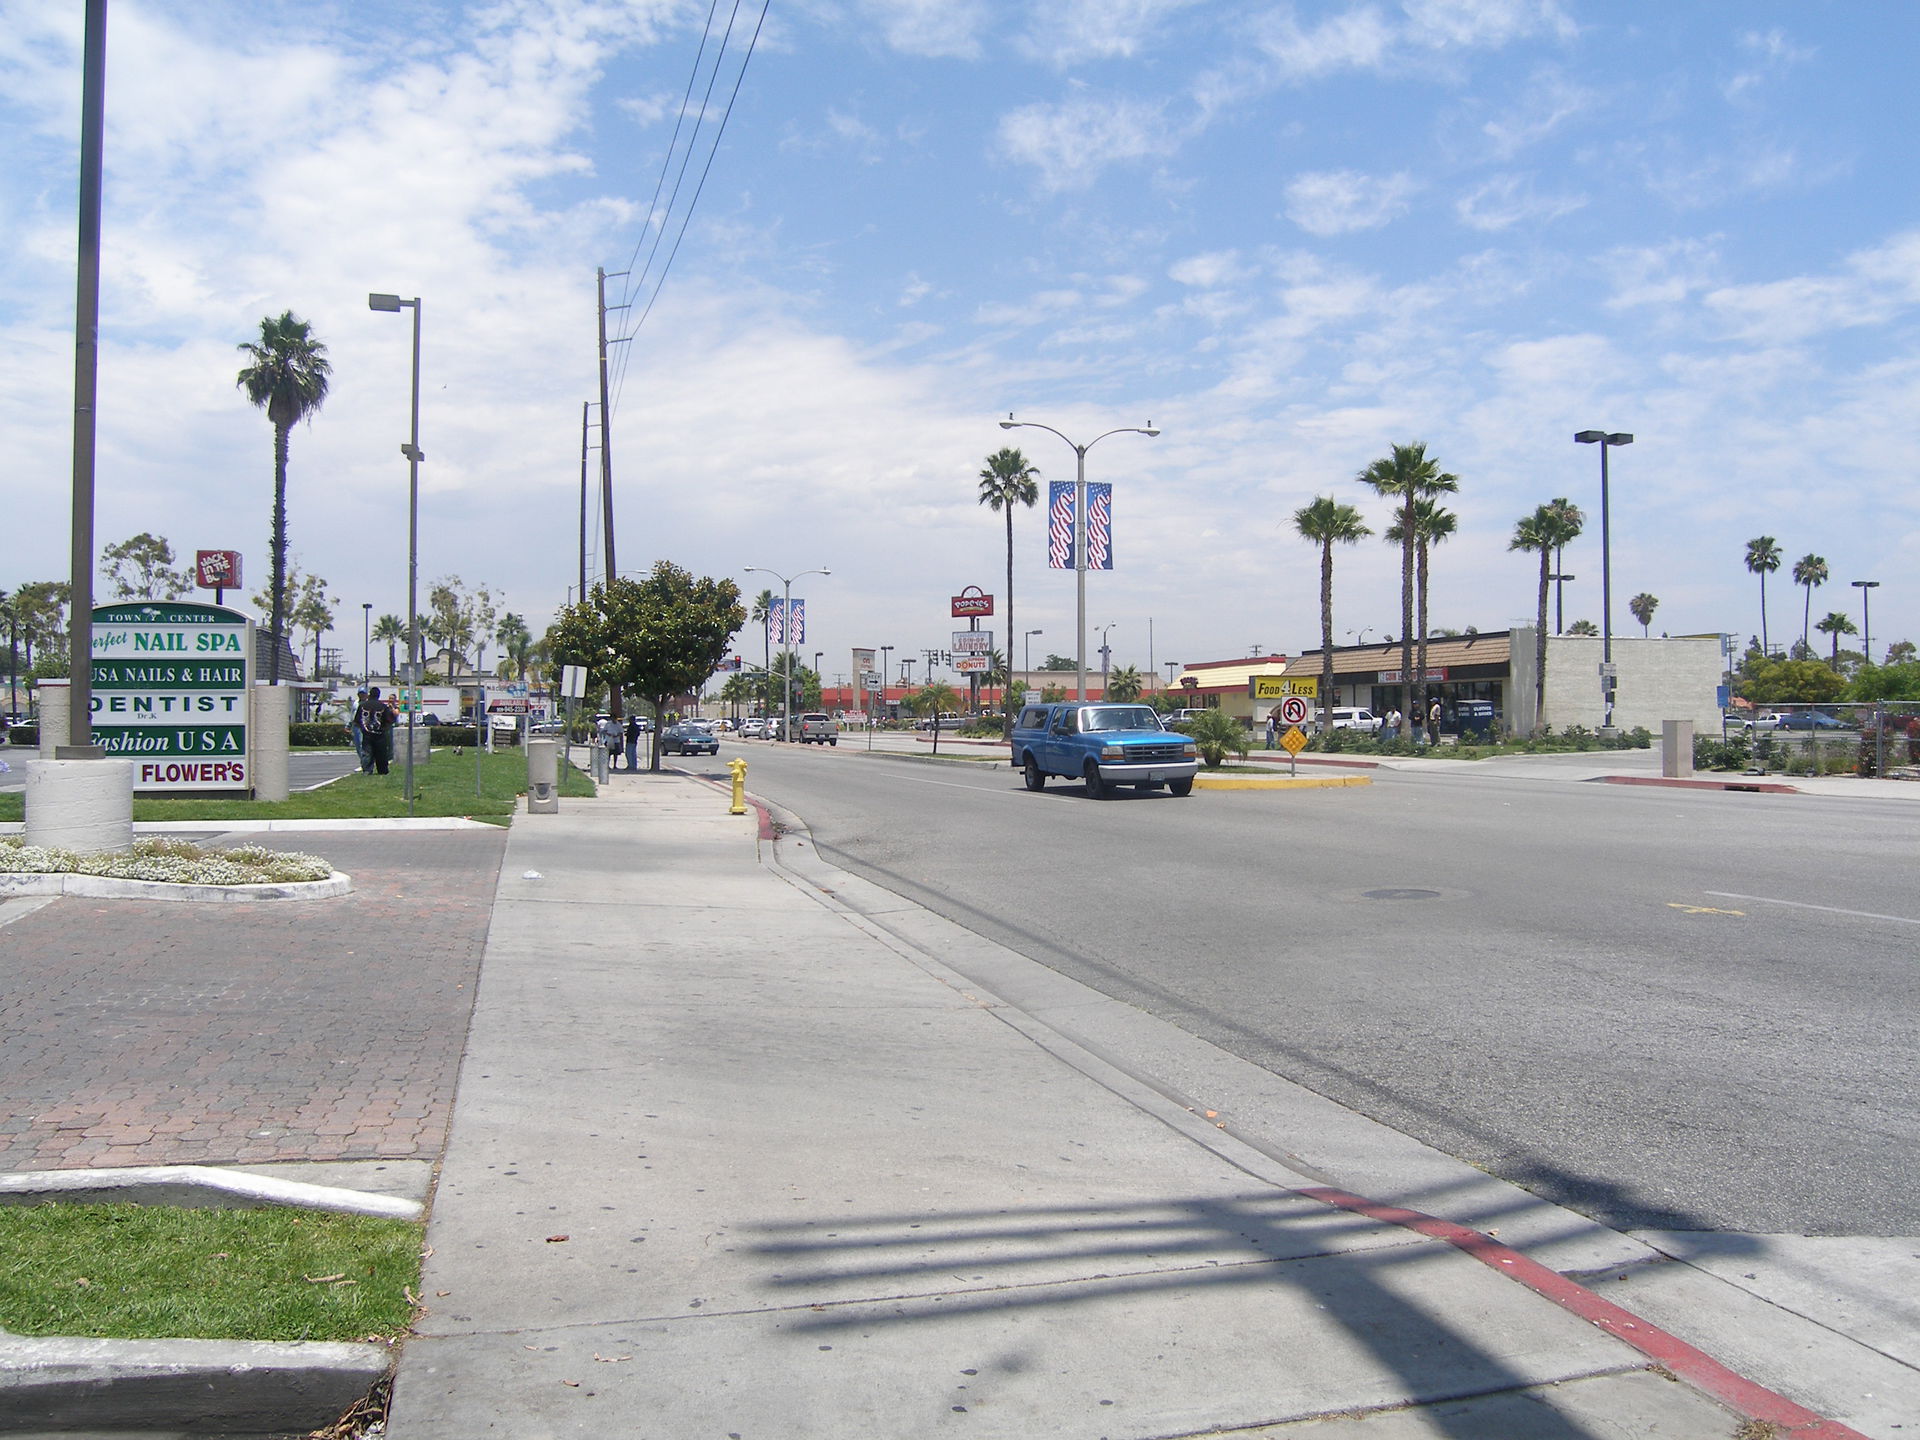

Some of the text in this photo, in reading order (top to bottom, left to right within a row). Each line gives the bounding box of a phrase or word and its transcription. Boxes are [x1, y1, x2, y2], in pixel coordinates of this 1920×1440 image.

[201, 552, 226, 567] JACK
[202, 560, 231, 576] IN THE
[170, 614, 215, 622] CENTER
[92, 632, 241, 652] erfect NAIL SPA
[125, 667, 175, 682] NAILS
[181, 667, 193, 682] &
[200, 668, 241, 682] HAIR
[1258, 679, 1313, 695] FOOD 4 LESS
[90, 696, 238, 712] DENTIST
[91, 731, 239, 751] Fashion USA
[142, 761, 244, 782] FLOWER'S
